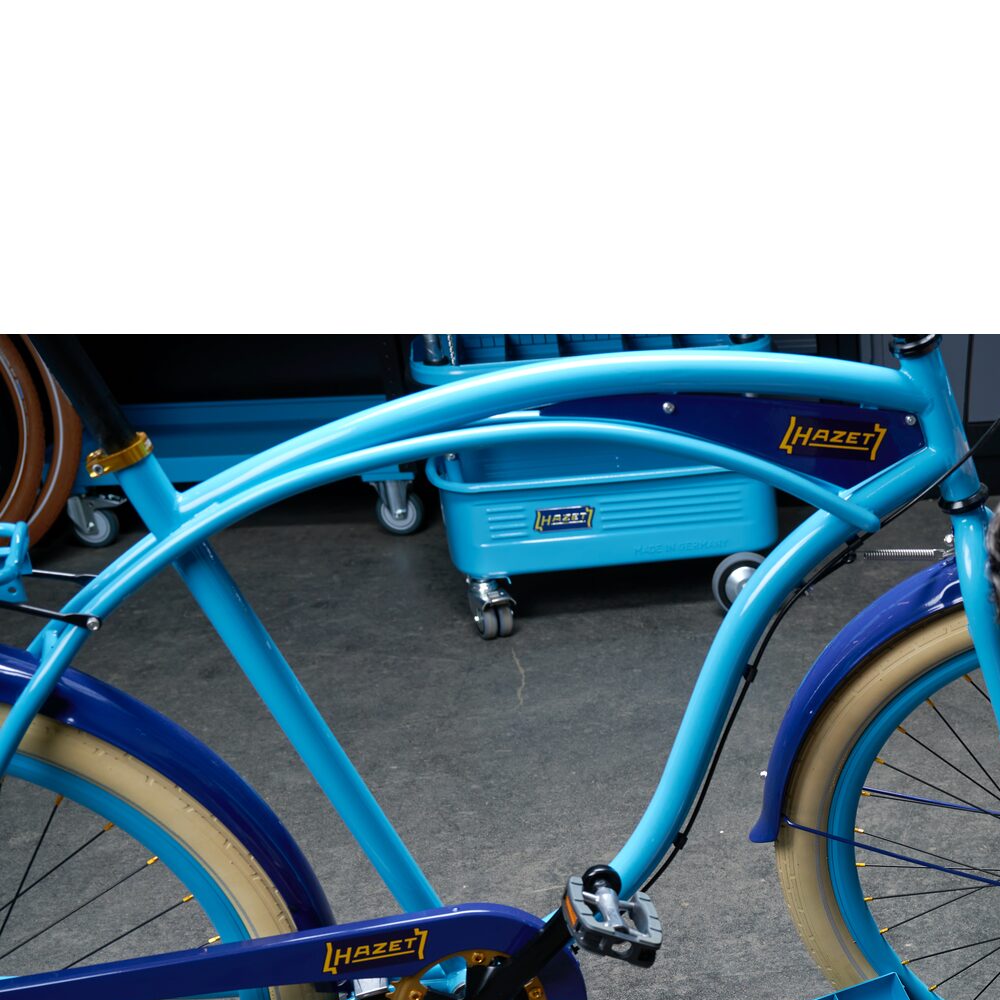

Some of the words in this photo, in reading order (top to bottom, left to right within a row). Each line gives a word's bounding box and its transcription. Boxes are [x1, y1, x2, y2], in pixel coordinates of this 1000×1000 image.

[789, 424, 879, 453] HAZET
[539, 510, 589, 528] HAZET
[332, 936, 419, 967] HAZET
